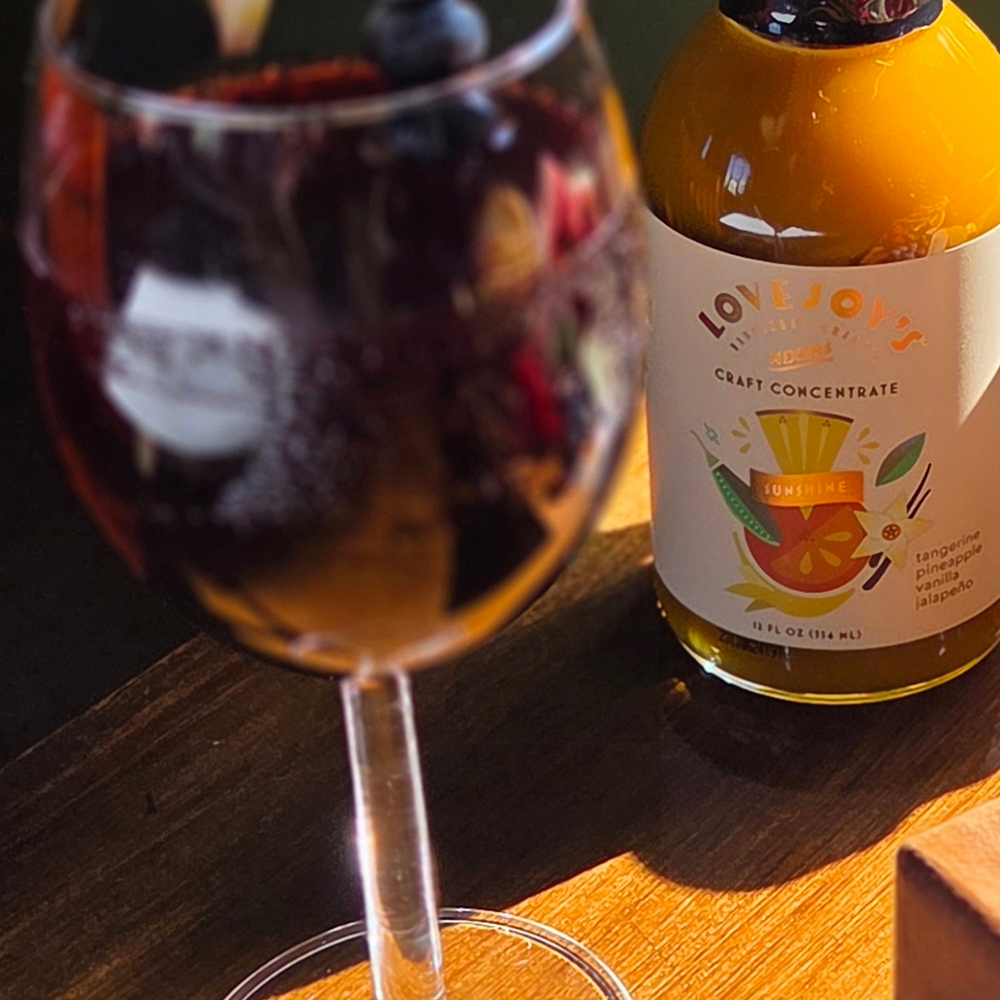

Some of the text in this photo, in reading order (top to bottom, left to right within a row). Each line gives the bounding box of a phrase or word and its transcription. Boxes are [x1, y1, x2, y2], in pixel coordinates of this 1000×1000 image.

[698, 279, 924, 352] LOVEJOY'S
[714, 367, 899, 399] CRAFT CONCENTRATE
[764, 480, 847, 497] SUNSHINE
[915, 530, 980, 563] tangerine
[916, 543, 982, 581] pineapple
[915, 570, 959, 593] vanilla
[916, 578, 974, 611] jalapeño
[753, 620, 763, 631] 12
[767, 623, 781, 635] FL
[785, 626, 805, 638] OZ
